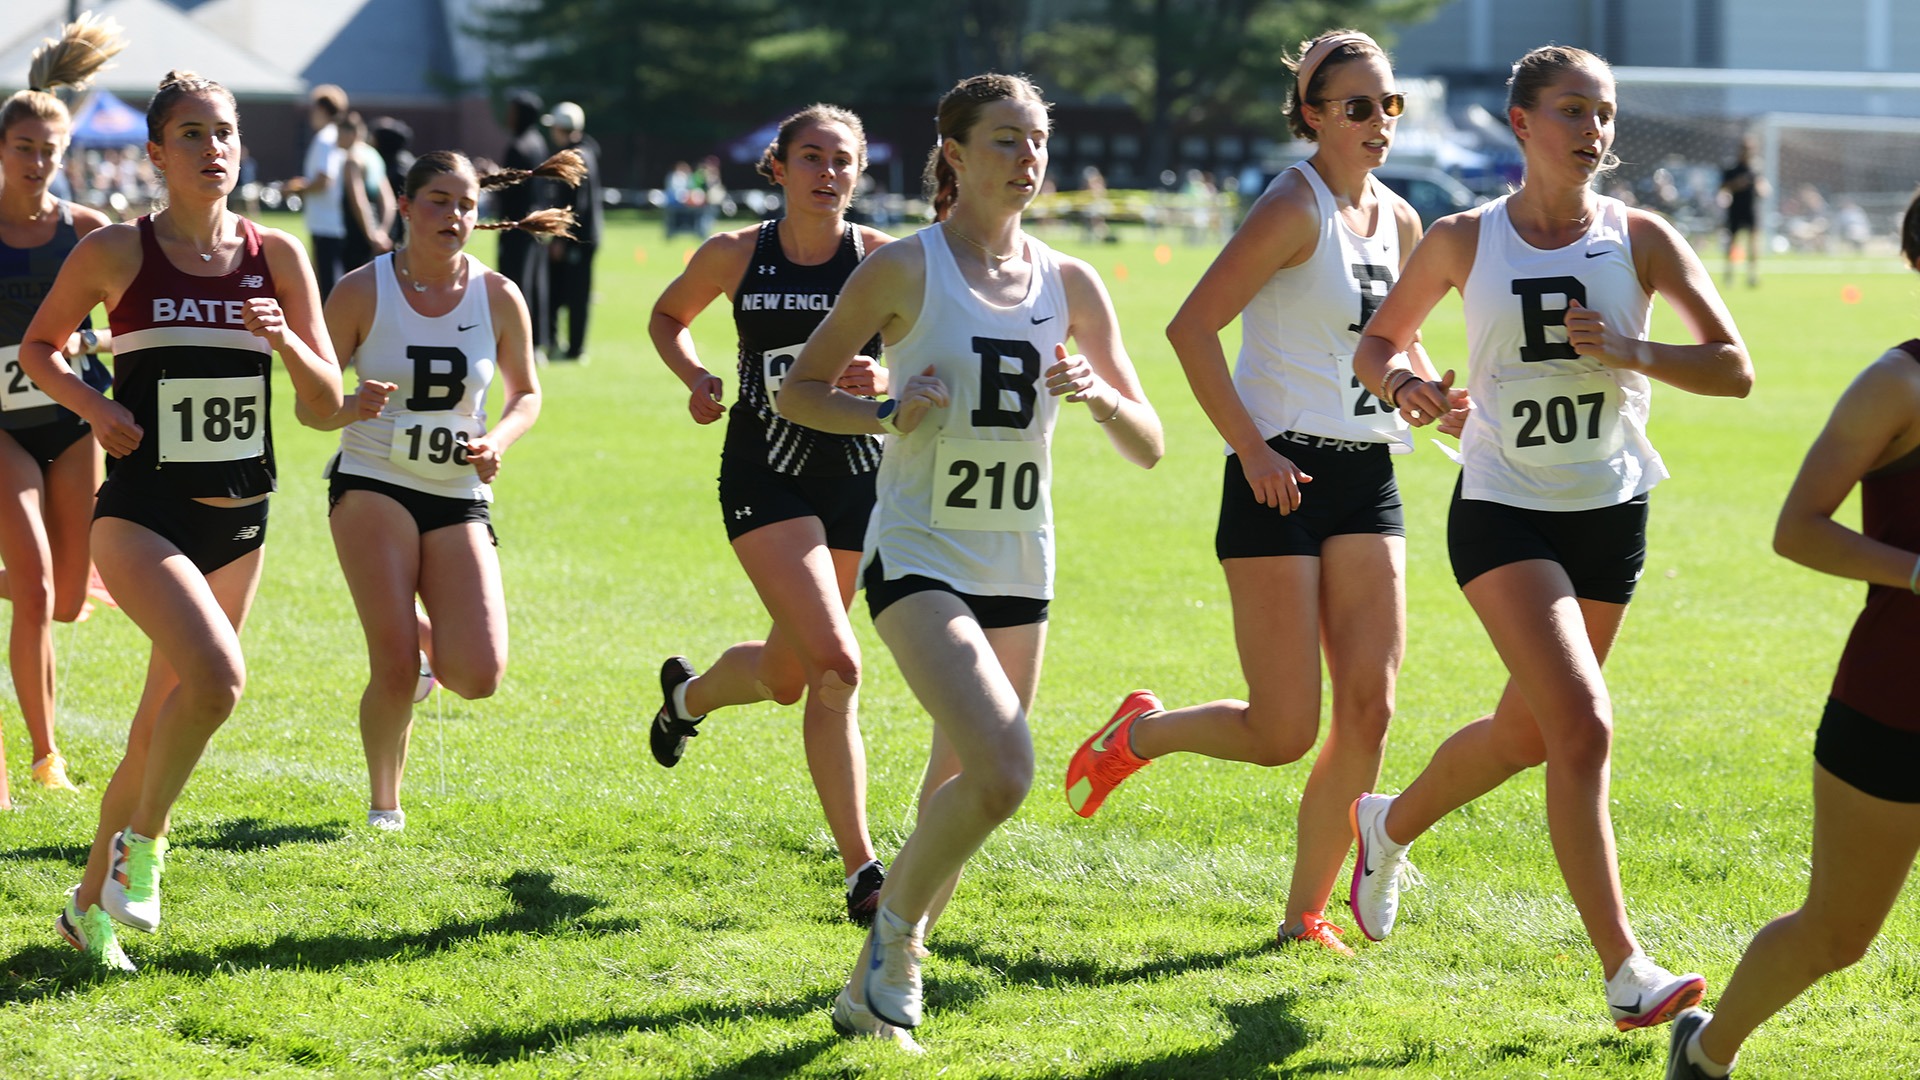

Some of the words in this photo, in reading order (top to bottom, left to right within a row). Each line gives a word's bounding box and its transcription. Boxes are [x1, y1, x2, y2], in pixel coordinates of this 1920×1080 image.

[152, 298, 244, 324] BATE
[741, 293, 782, 312] NEW
[1511, 275, 1588, 363] B
[406, 345, 468, 412] B
[971, 336, 1041, 430] B
[1351, 374, 1395, 416] 2
[172, 395, 257, 442] 185
[1512, 391, 1605, 448] 207
[945, 459, 1040, 511] 210
